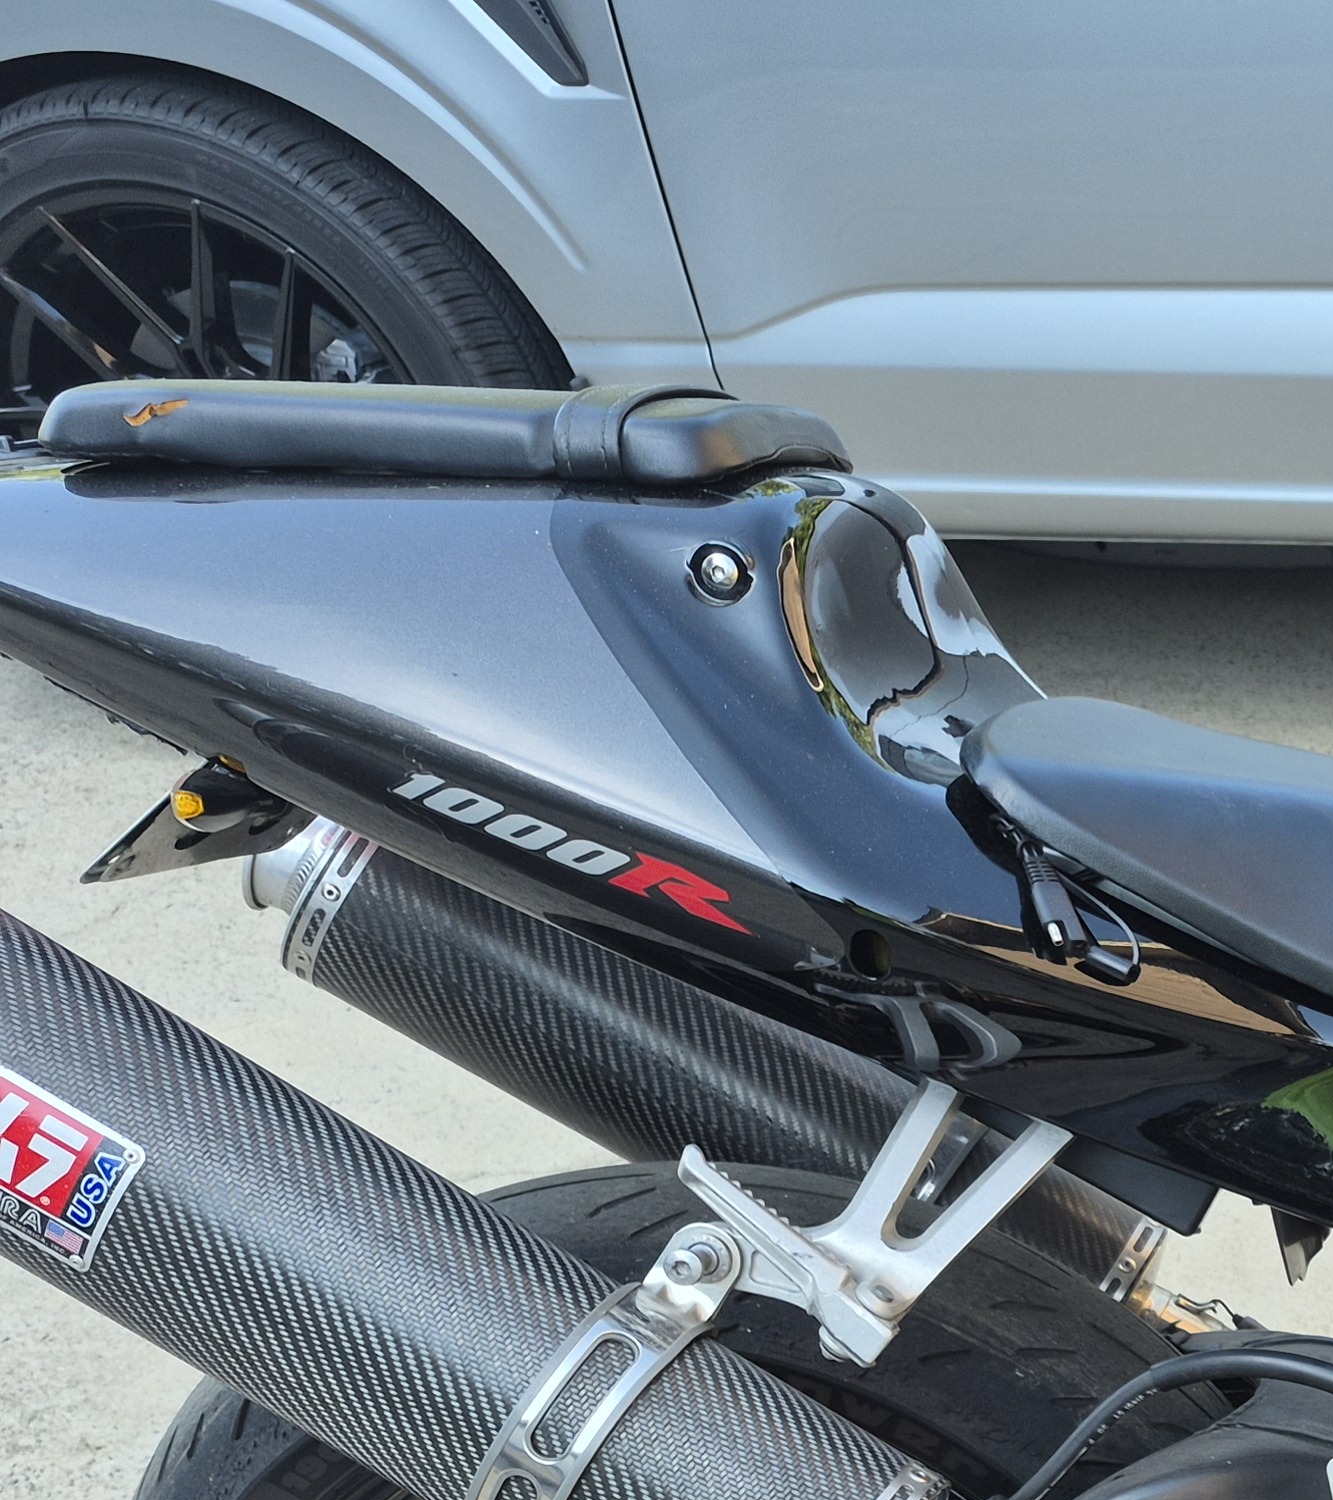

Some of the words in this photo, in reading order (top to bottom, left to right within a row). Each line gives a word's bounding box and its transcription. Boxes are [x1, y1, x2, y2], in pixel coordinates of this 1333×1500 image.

[392, 773, 758, 938] 1000R
[0, 1193, 43, 1234] RA
[66, 1151, 125, 1227] USA
